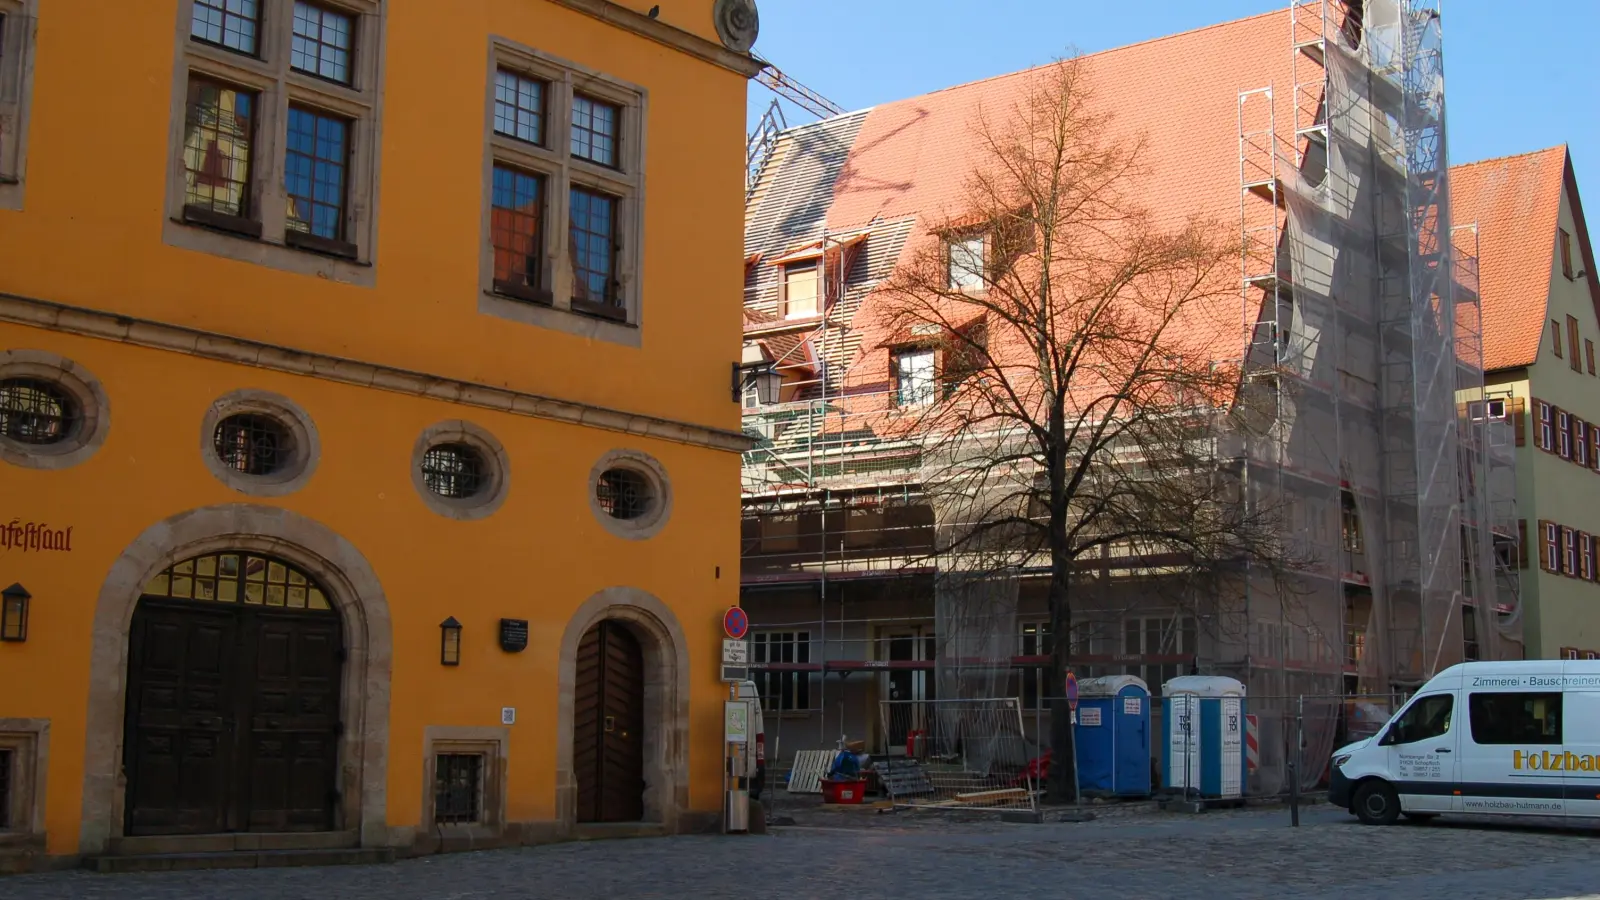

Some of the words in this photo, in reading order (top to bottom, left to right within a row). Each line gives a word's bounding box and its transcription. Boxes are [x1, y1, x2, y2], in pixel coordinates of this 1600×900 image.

[1473, 677, 1520, 686] Zimmerei
[1529, 676, 1600, 686] Bauschreiner
[1465, 800, 1562, 810] www.holzbau-hutmann.de
